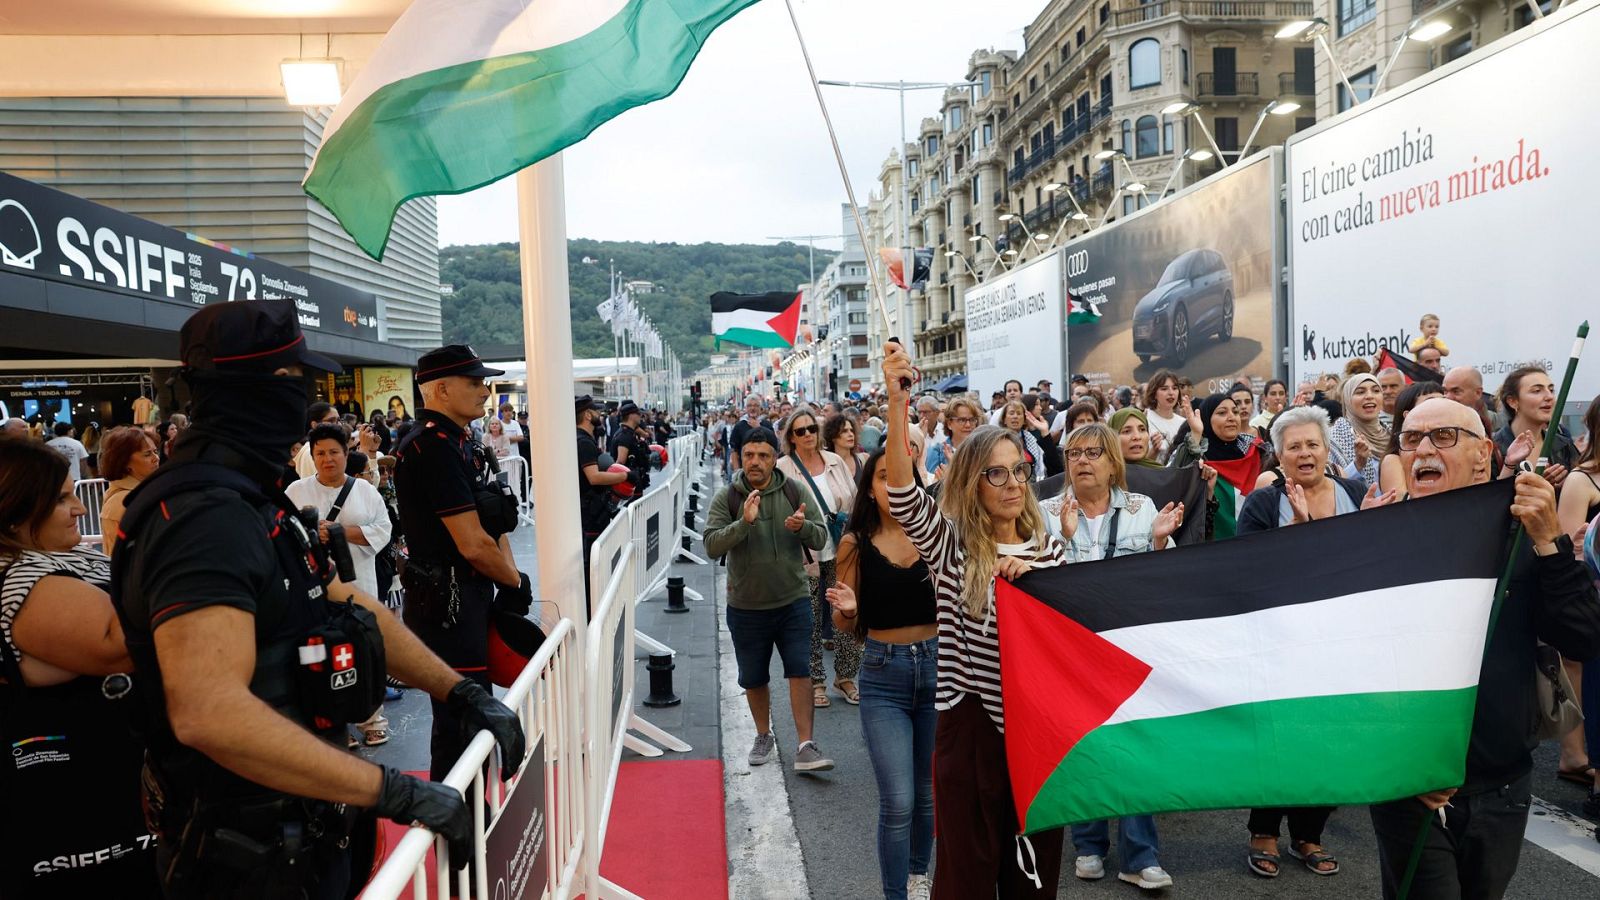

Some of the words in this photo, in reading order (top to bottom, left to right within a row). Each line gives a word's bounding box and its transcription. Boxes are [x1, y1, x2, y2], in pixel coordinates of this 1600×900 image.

[1302, 167, 1316, 204] El
[1321, 160, 1357, 196] cine
[1362, 126, 1435, 183] cambia
[1301, 213, 1330, 243] con
[1334, 191, 1375, 233] cada
[1379, 178, 1441, 223] nueva
[1447, 137, 1550, 204] mirada.
[57, 216, 186, 298] SSIFF
[220, 261, 257, 302] 73
[1078, 281, 1098, 296] quienes
[1098, 276, 1116, 292] pasan
[1322, 328, 1411, 360] kutxabank
[1481, 361, 1496, 375] del
[33, 847, 110, 877] SSIFF
